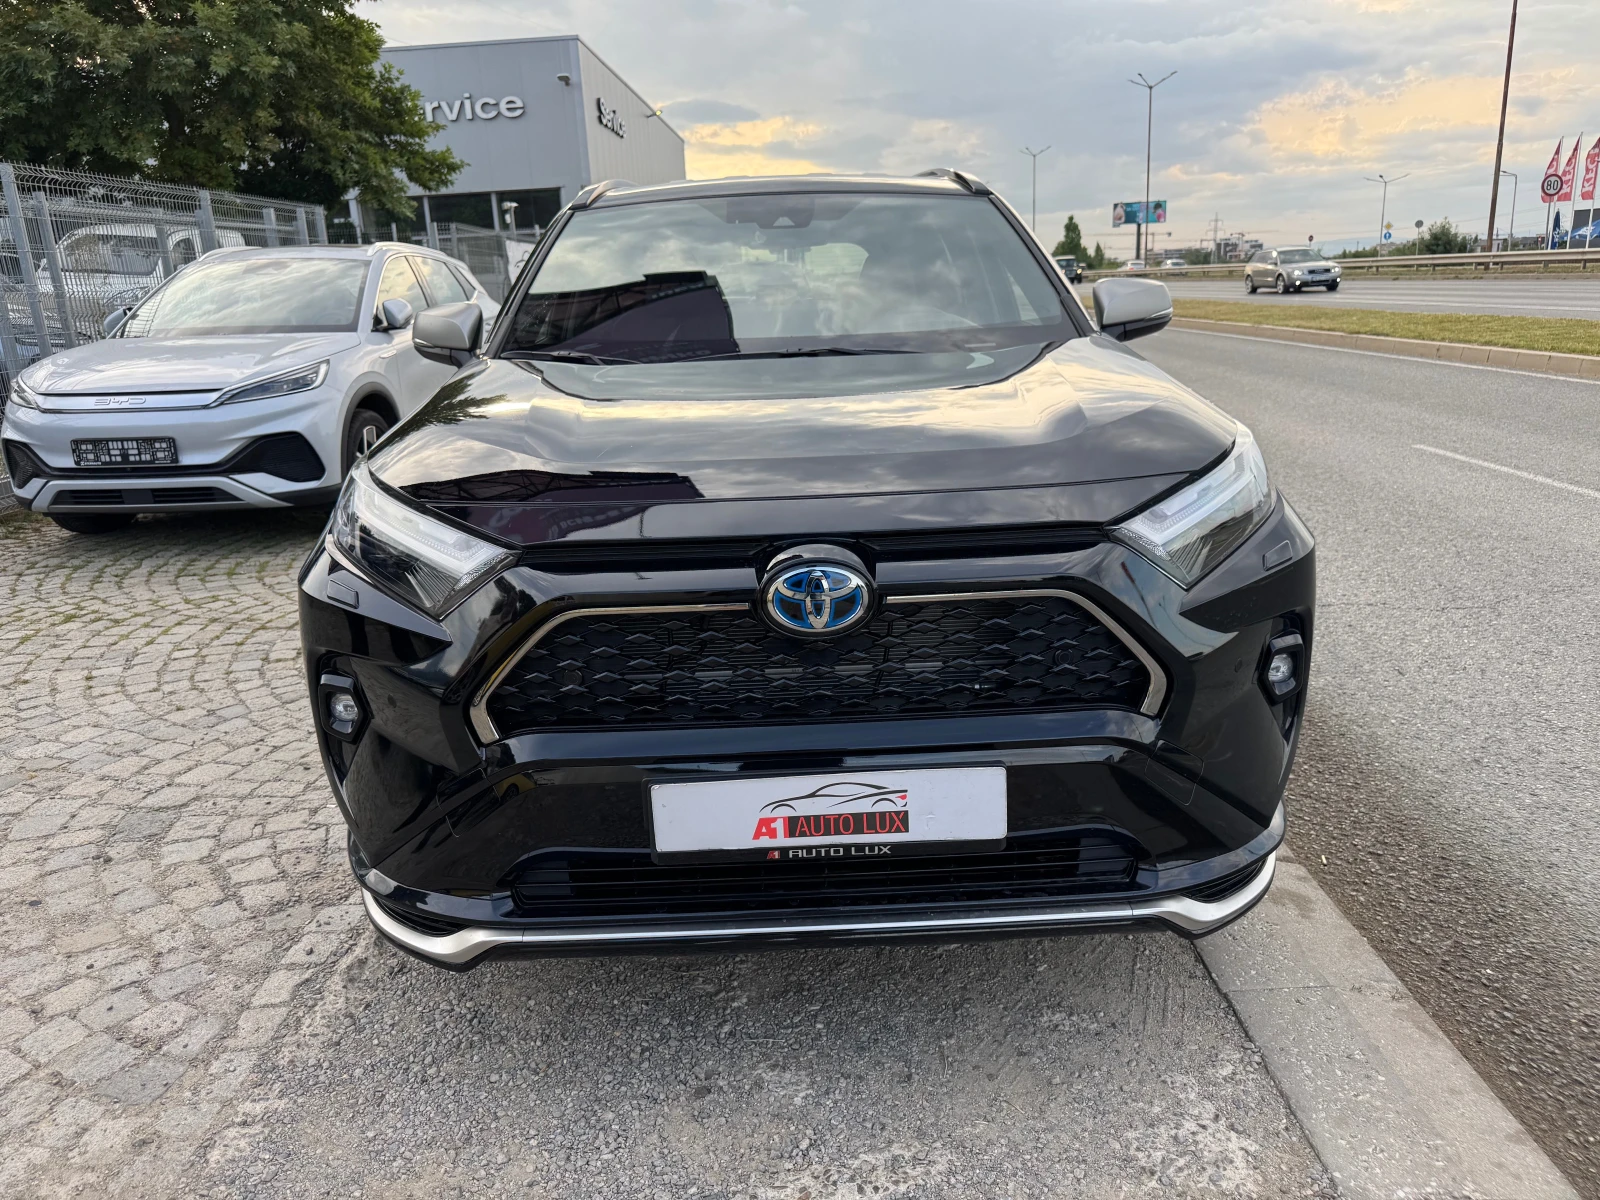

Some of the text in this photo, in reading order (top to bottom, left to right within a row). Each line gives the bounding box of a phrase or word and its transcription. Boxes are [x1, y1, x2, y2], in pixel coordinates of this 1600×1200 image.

[421, 92, 525, 123] rvice
[596, 97, 627, 139] Service
[1546, 179, 1559, 191] 80
[94, 397, 146, 406] BYD
[752, 812, 905, 840] A1 AUTO LUX
[767, 845, 891, 859] A1 AUTO LUX
